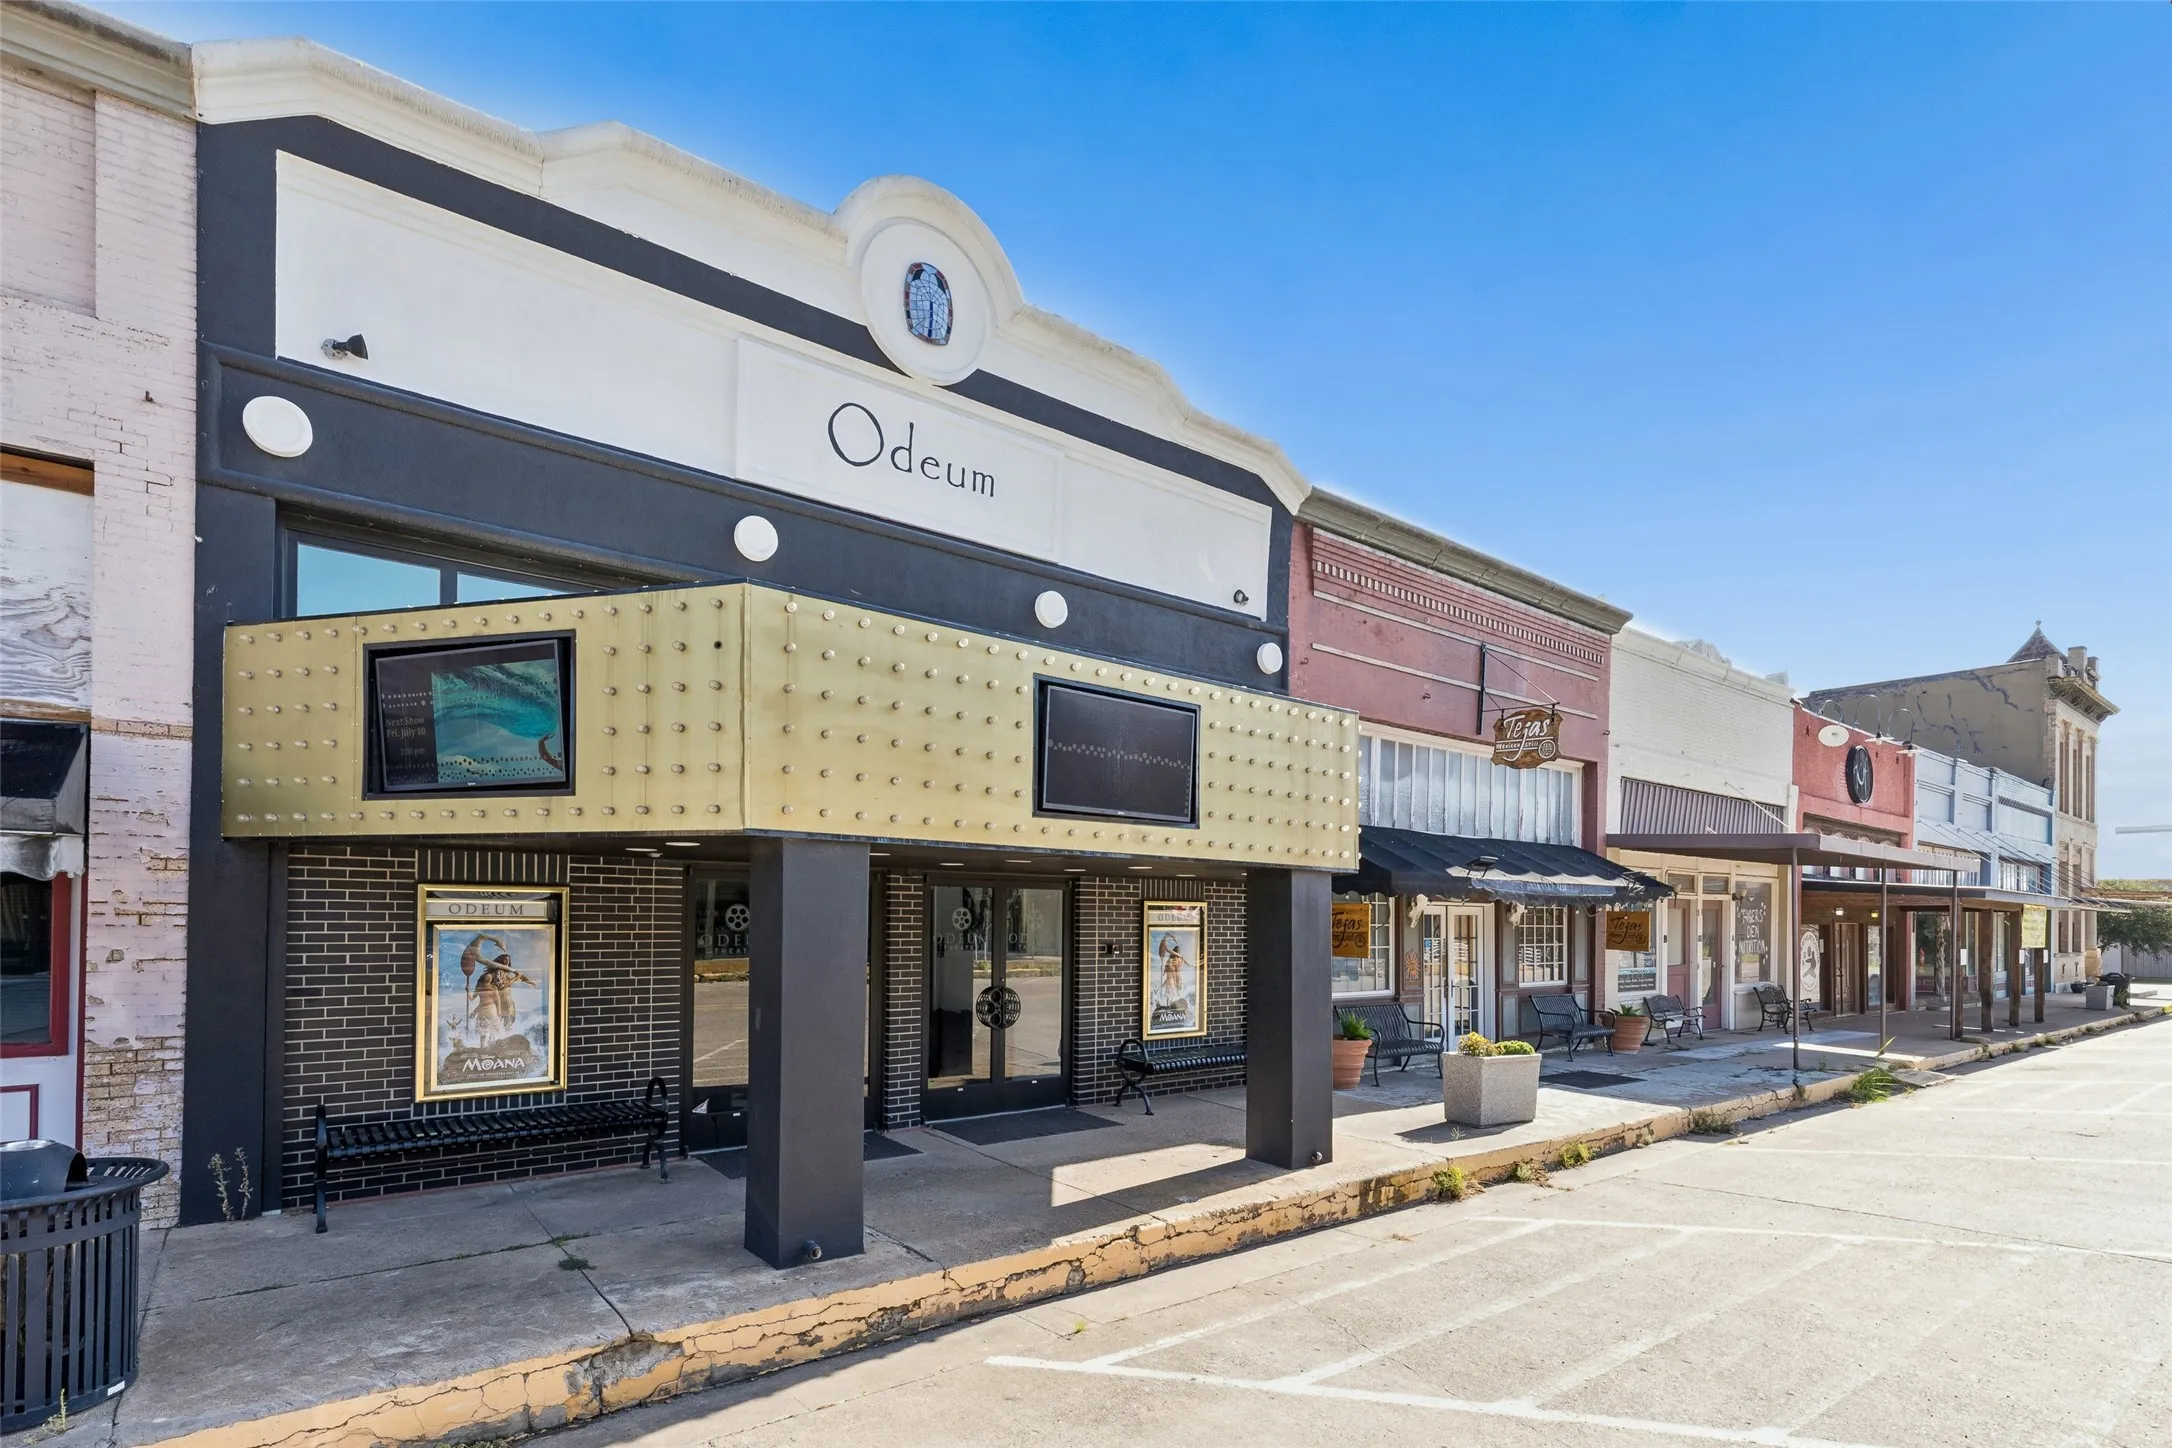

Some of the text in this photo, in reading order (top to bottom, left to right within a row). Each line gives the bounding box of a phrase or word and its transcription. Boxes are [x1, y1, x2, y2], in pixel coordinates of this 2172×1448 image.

[827, 402, 995, 497] Odeum
[386, 716, 425, 727] Next Show
[386, 726, 426, 740] Fri. July 10
[1503, 714, 1550, 761] Tejas
[448, 903, 524, 915] ODEUM
[1332, 911, 1363, 948] Tejas
[1610, 916, 1643, 945] Tejas
[1746, 924, 1760, 939] DEN
[1738, 939, 1766, 955] NUTRITION
[1160, 1012, 1186, 1021] MOANA
[462, 1057, 526, 1072] MOANA
